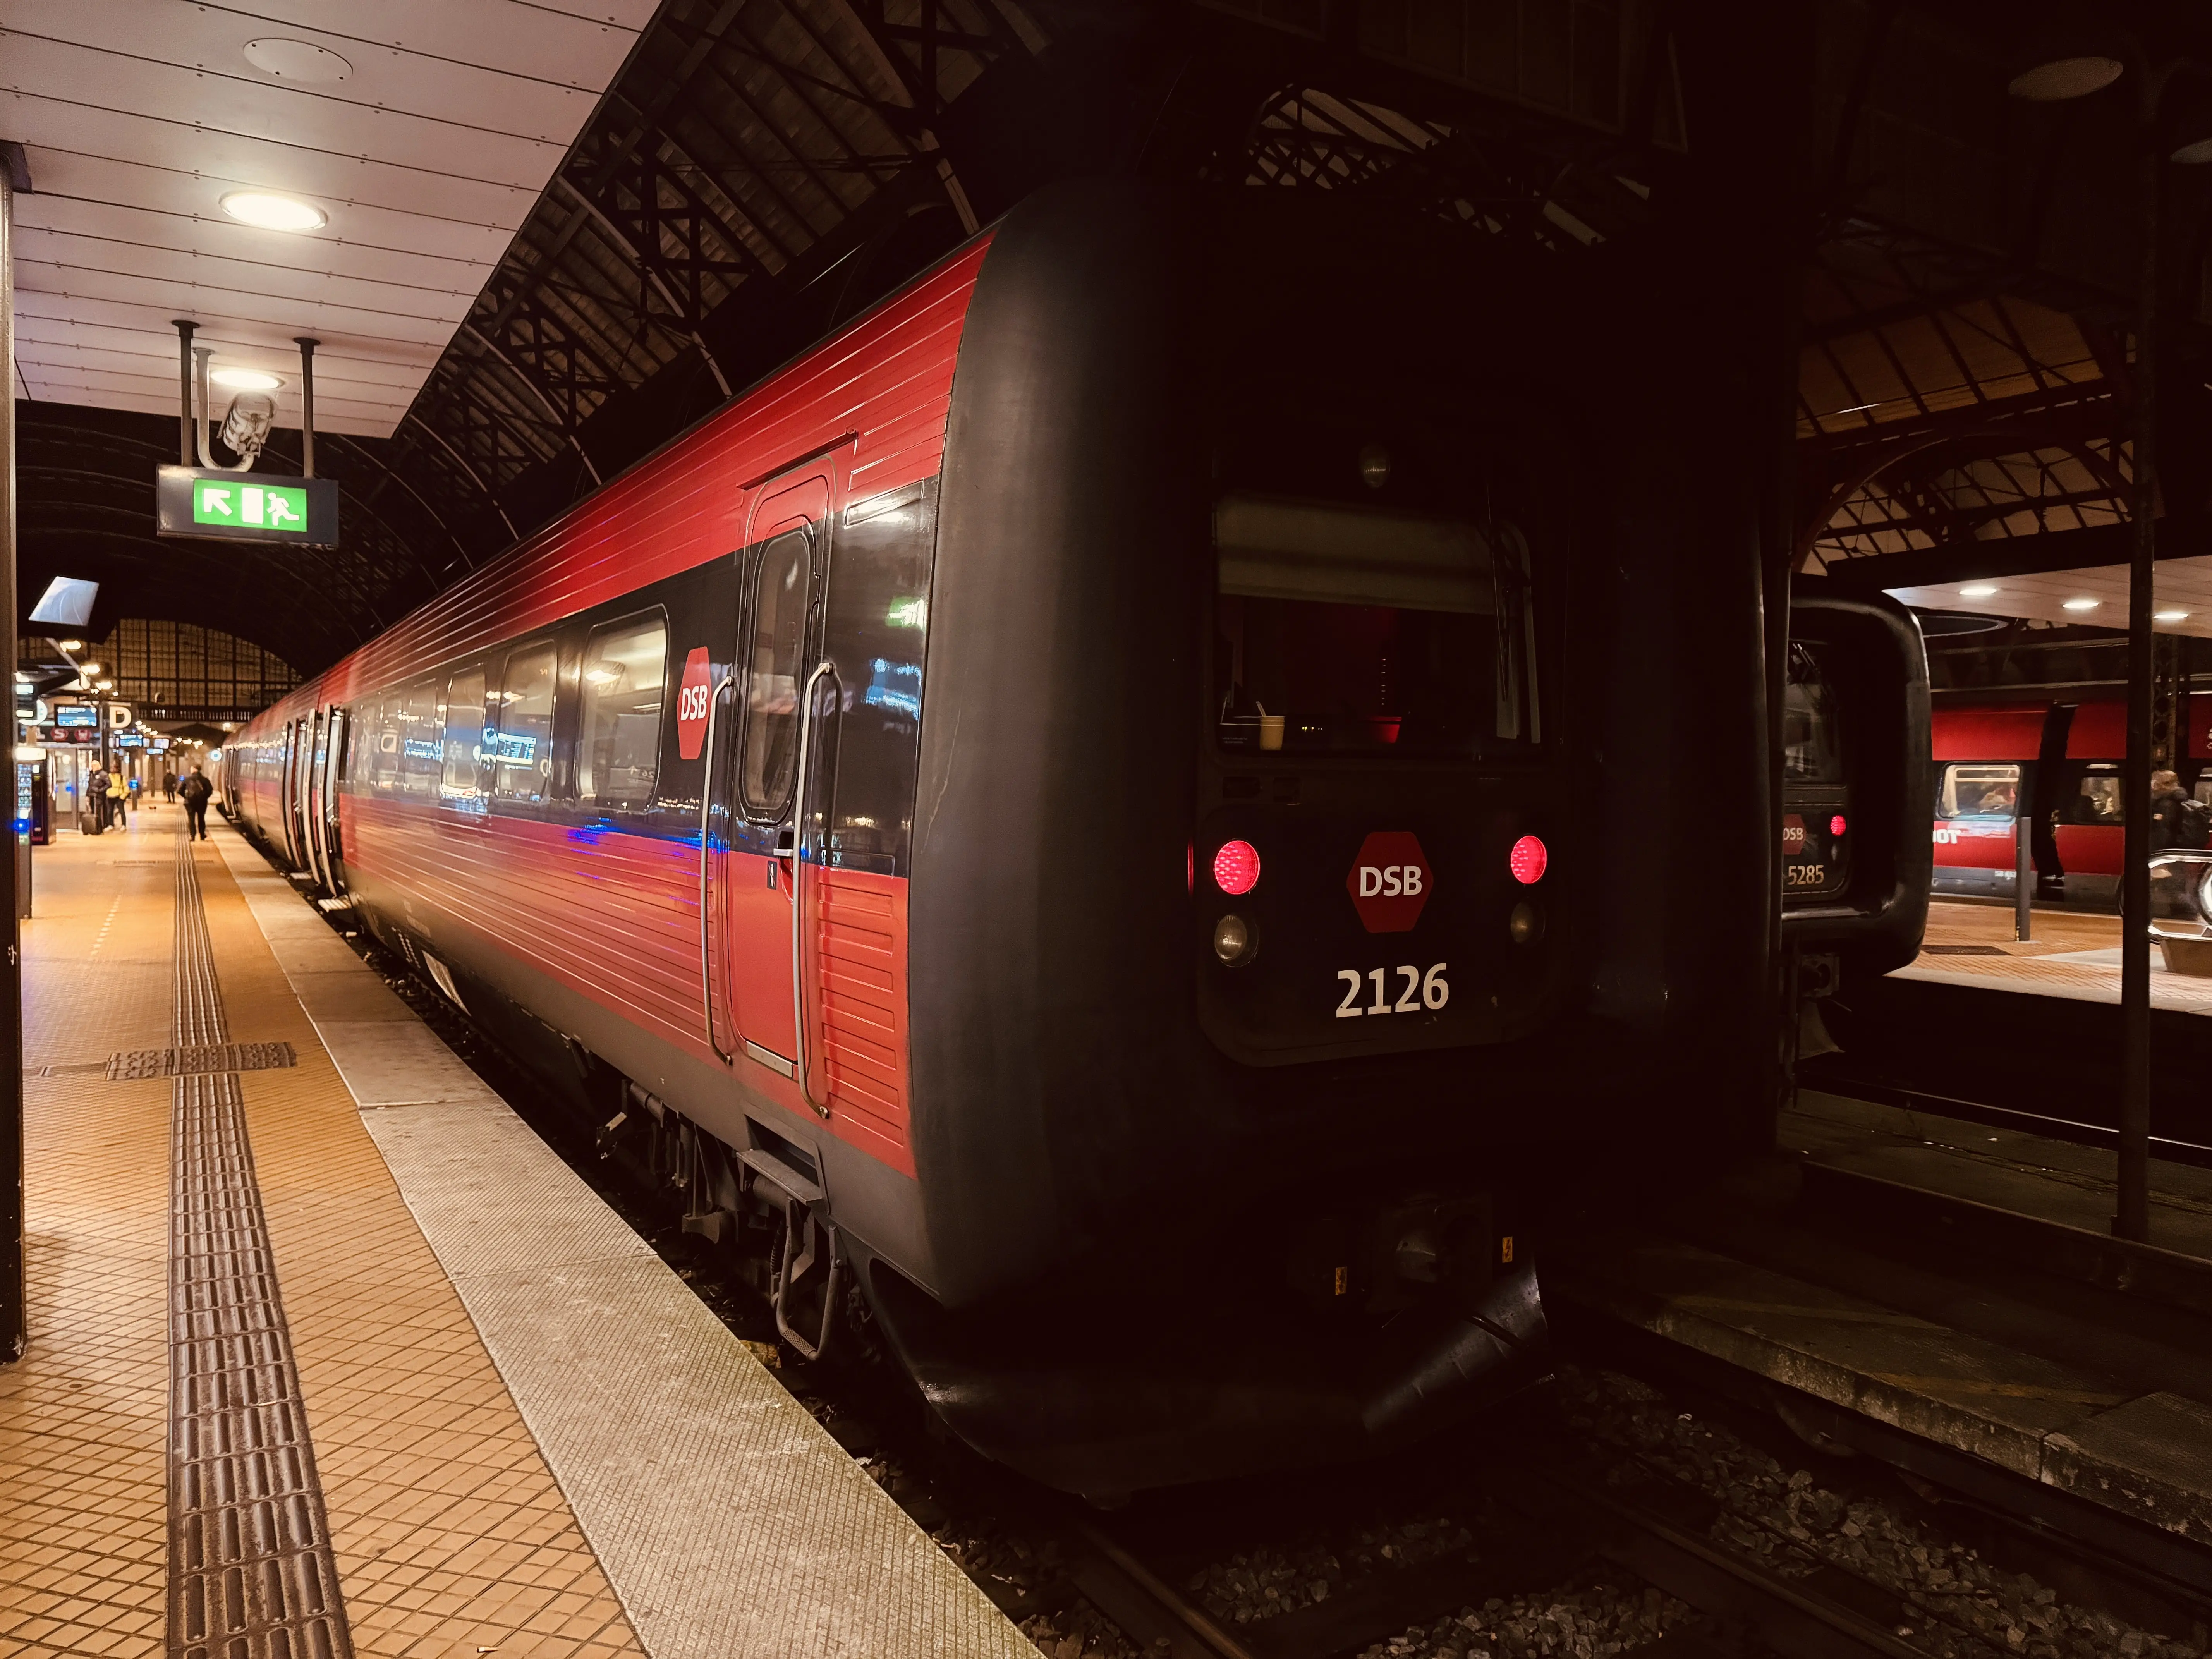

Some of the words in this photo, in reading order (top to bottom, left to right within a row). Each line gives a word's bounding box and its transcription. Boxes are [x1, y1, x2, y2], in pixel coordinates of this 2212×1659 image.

[680, 685, 708, 721] DSB
[110, 706, 131, 728] D
[54, 728, 65, 739] S
[1783, 827, 1803, 841] DSB
[1360, 866, 1422, 896] DSB
[1788, 865, 1824, 885] 5285
[1336, 963, 1448, 1017] 2126
